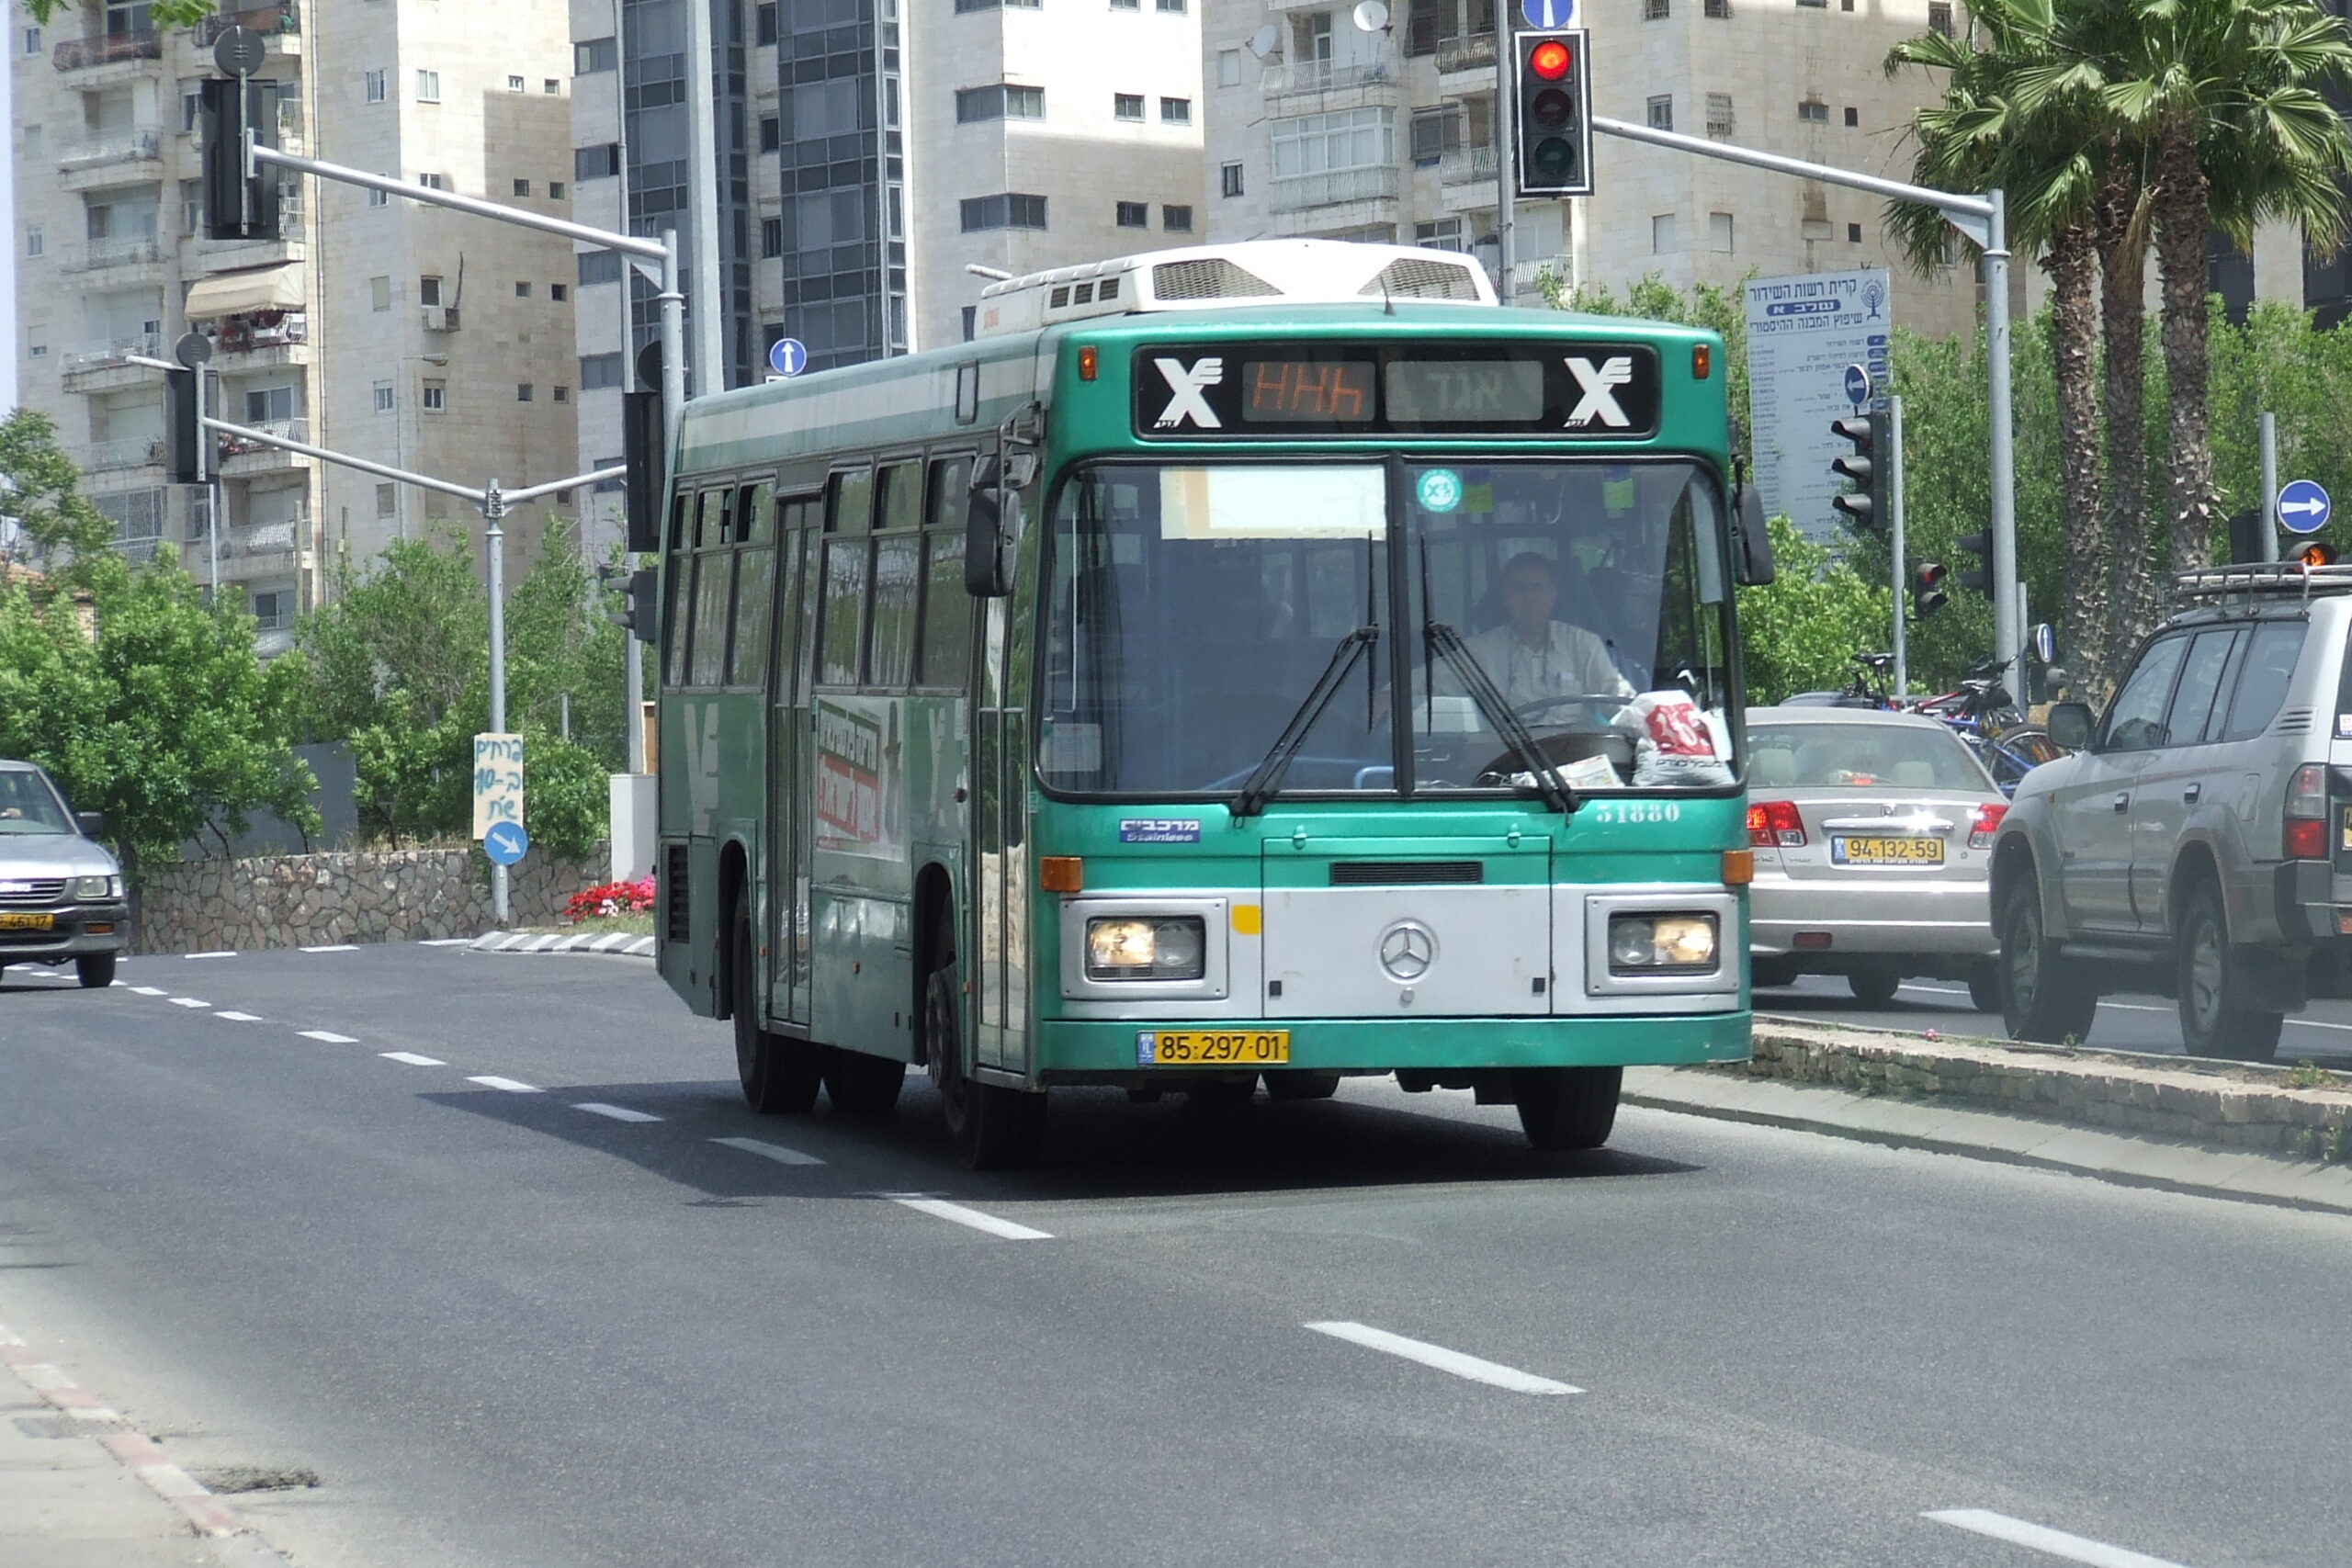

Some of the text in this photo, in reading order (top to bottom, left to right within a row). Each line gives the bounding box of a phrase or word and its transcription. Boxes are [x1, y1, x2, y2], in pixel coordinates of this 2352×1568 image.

[1749, 279, 1857, 301] קרית רשות השידור
[1772, 301, 1835, 314] שלב א
[1749, 312, 1862, 333] שיפוץ המבנה ההיסטורי
[476, 739, 523, 763] פרחים
[1120, 819, 1200, 831] מרכבים
[1126, 831, 1193, 842] Stainless
